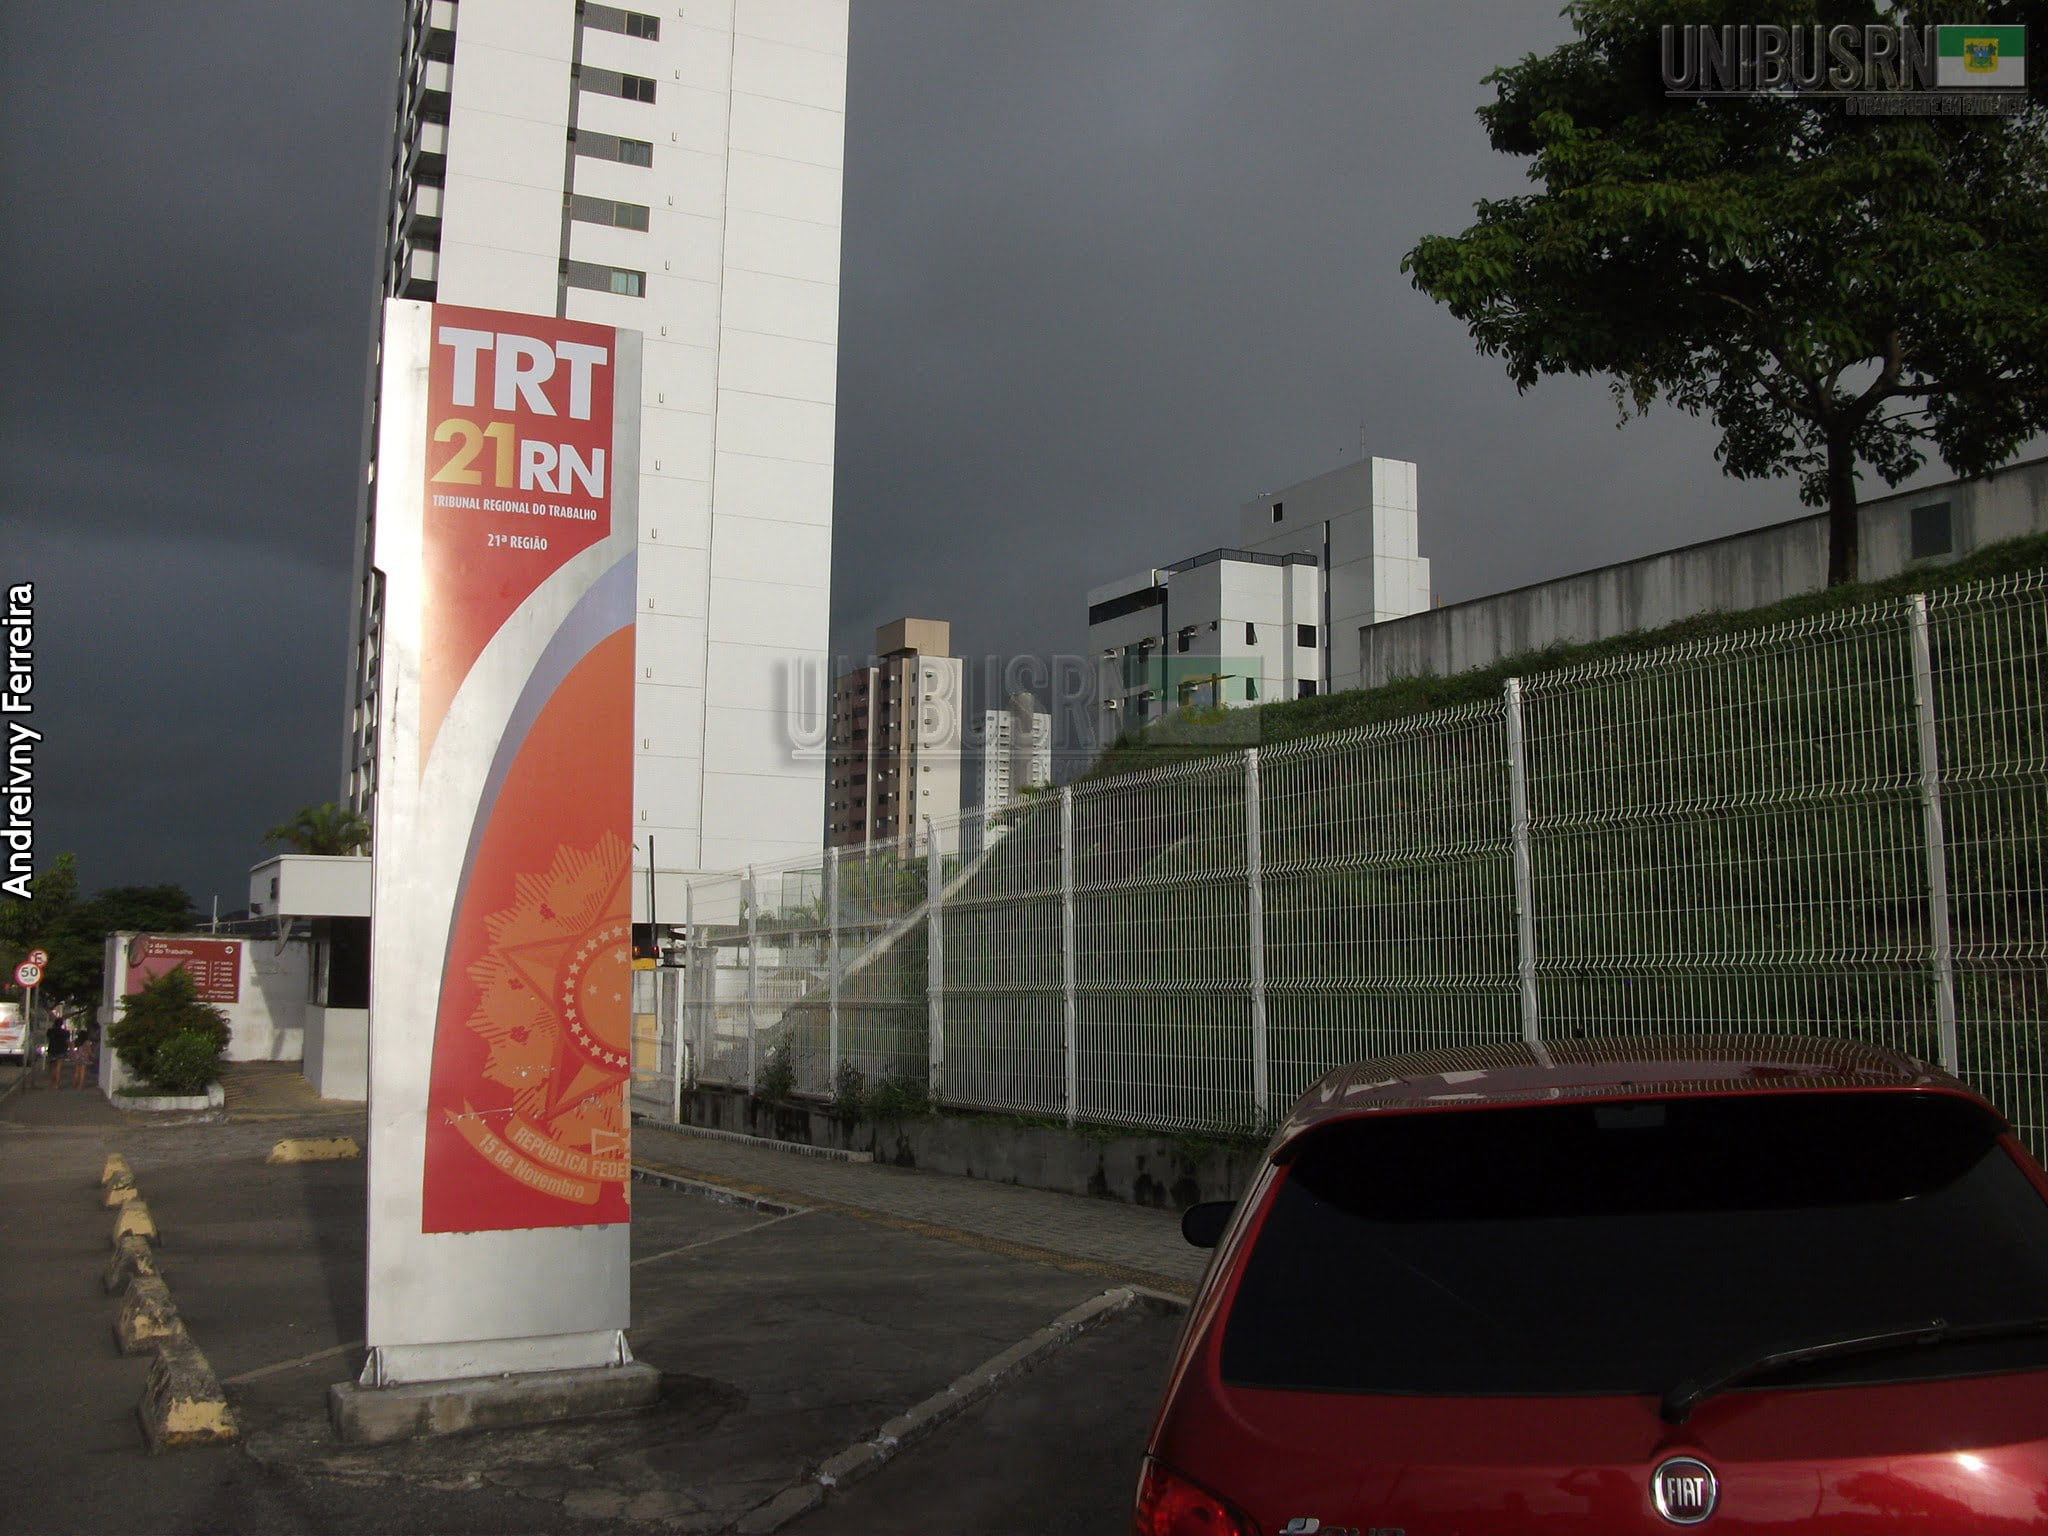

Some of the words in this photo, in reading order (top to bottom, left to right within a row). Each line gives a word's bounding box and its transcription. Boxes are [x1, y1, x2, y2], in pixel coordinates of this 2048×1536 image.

[438, 326, 608, 421] TRT
[432, 495, 480, 510] TRIBUNAL
[483, 499, 530, 514] REGIONAL
[533, 503, 546, 515] DO
[549, 505, 597, 521] TRABALHO
[487, 533, 508, 547] 21ª
[510, 535, 548, 551] REGIÃO
[21, 967, 38, 977] 50
[480, 1134, 499, 1153] 15
[495, 1150, 514, 1168] de
[513, 1160, 585, 1198] Novembro
[1666, 1477, 1704, 1507] FIAT
